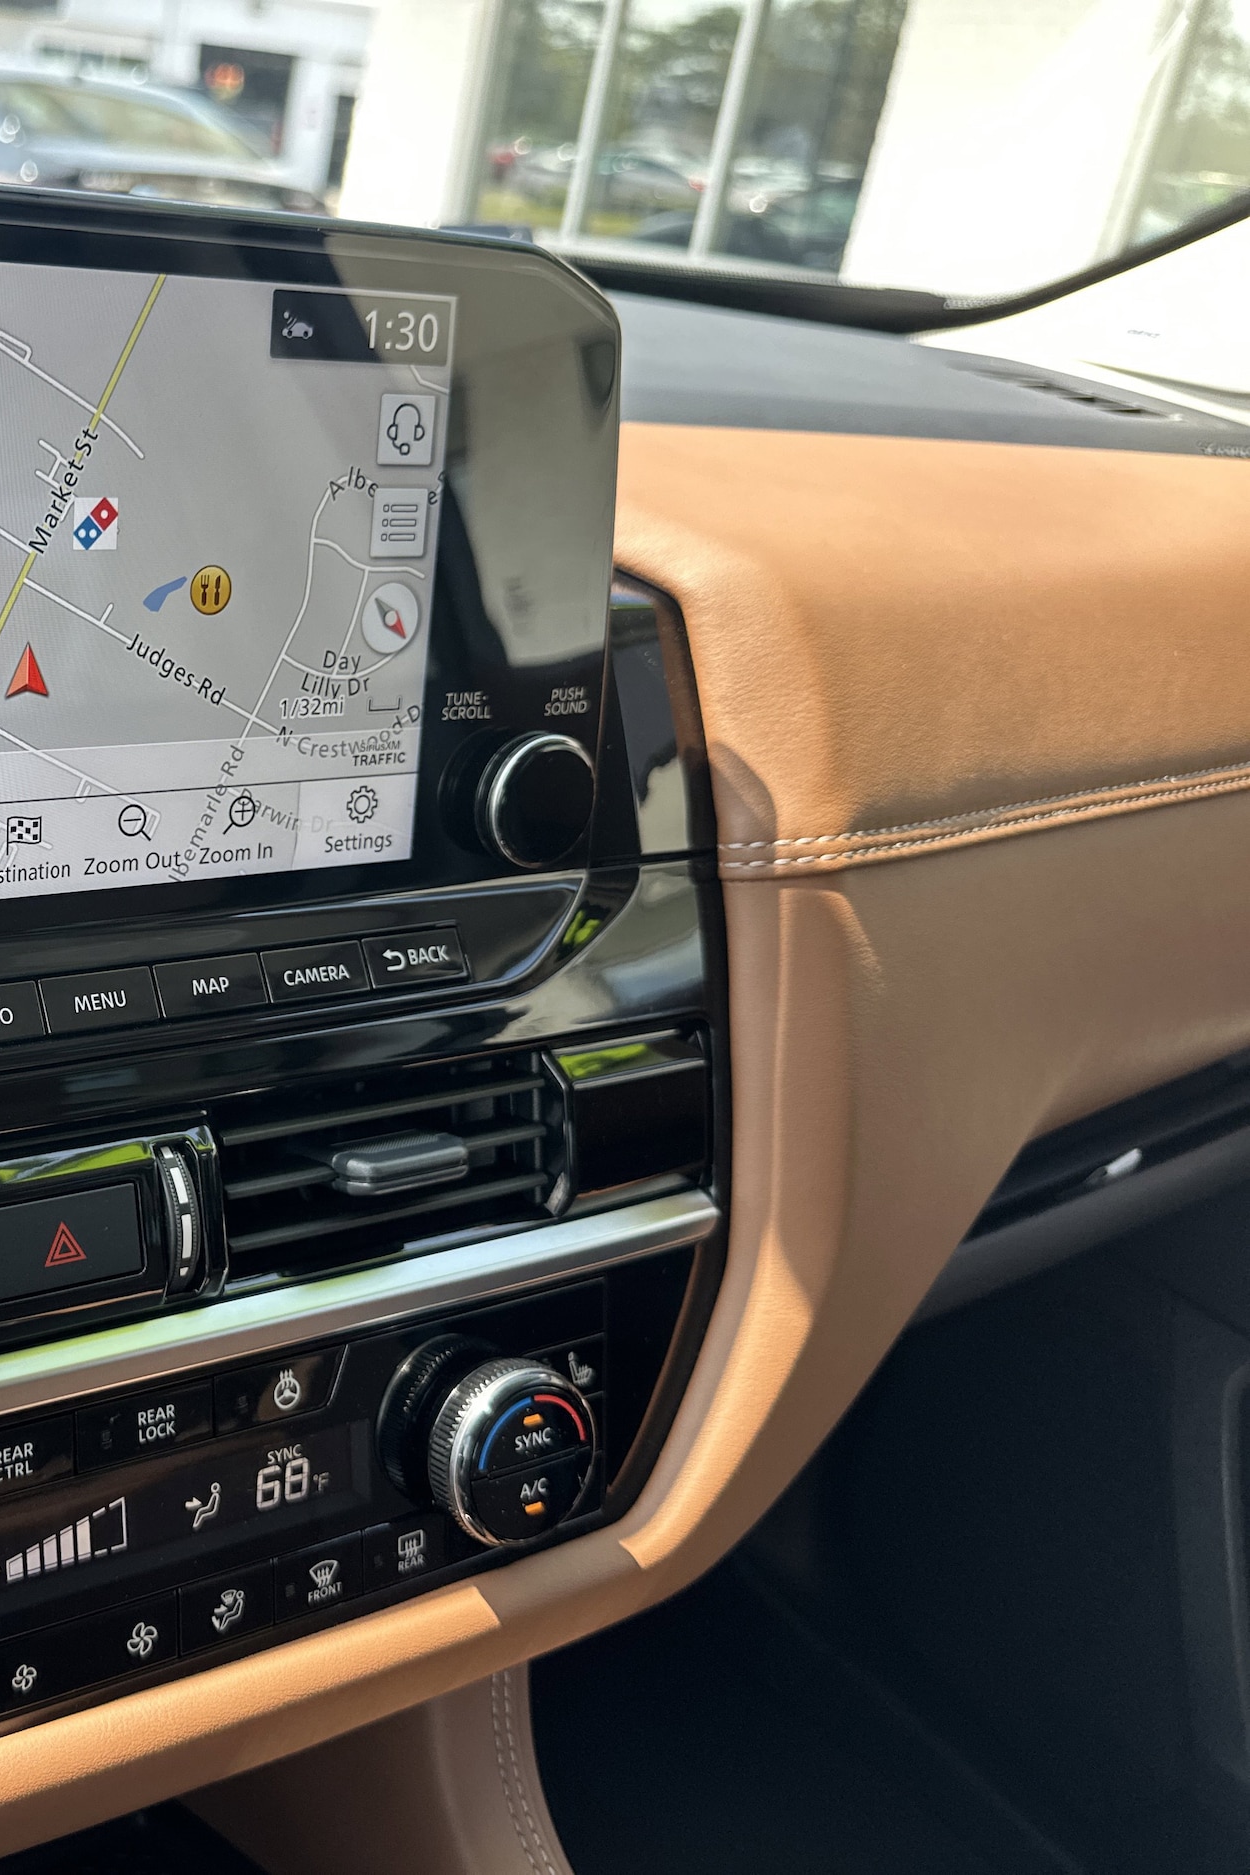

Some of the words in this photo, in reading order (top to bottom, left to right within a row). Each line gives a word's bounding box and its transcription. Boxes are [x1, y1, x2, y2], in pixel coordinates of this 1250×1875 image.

[365, 310, 439, 353] 1:30
[29, 459, 84, 554] Market
[75, 428, 99, 456] St
[126, 633, 194, 688] Judges
[197, 676, 227, 706] Rd
[322, 650, 362, 675] Day
[300, 673, 342, 700] Lilly
[347, 677, 371, 697] Dr
[550, 686, 586, 701] PUSH
[279, 697, 344, 718] 1/32mi
[441, 705, 492, 721] SCROLL
[543, 700, 589, 717] SOUND
[276, 725, 294, 747] N
[220, 744, 246, 777] Rd
[352, 752, 406, 767] TRAFFIC
[198, 847, 251, 865] Zoom
[257, 842, 273, 860] In
[324, 833, 393, 854] Settings
[83, 857, 139, 876] Zoom
[145, 851, 182, 871] Out
[407, 944, 450, 967] BACK
[191, 976, 230, 997] MAP
[283, 963, 351, 988] CAMERA
[74, 989, 127, 1014] MENU
[137, 1403, 176, 1427] REAR
[138, 1420, 176, 1445] LOCK
[514, 1426, 553, 1451] SYNC
[266, 1442, 304, 1464] SYNC
[519, 1476, 548, 1500] A/C
[397, 1553, 425, 1572] REAR
[306, 1579, 343, 1603] FRONT
